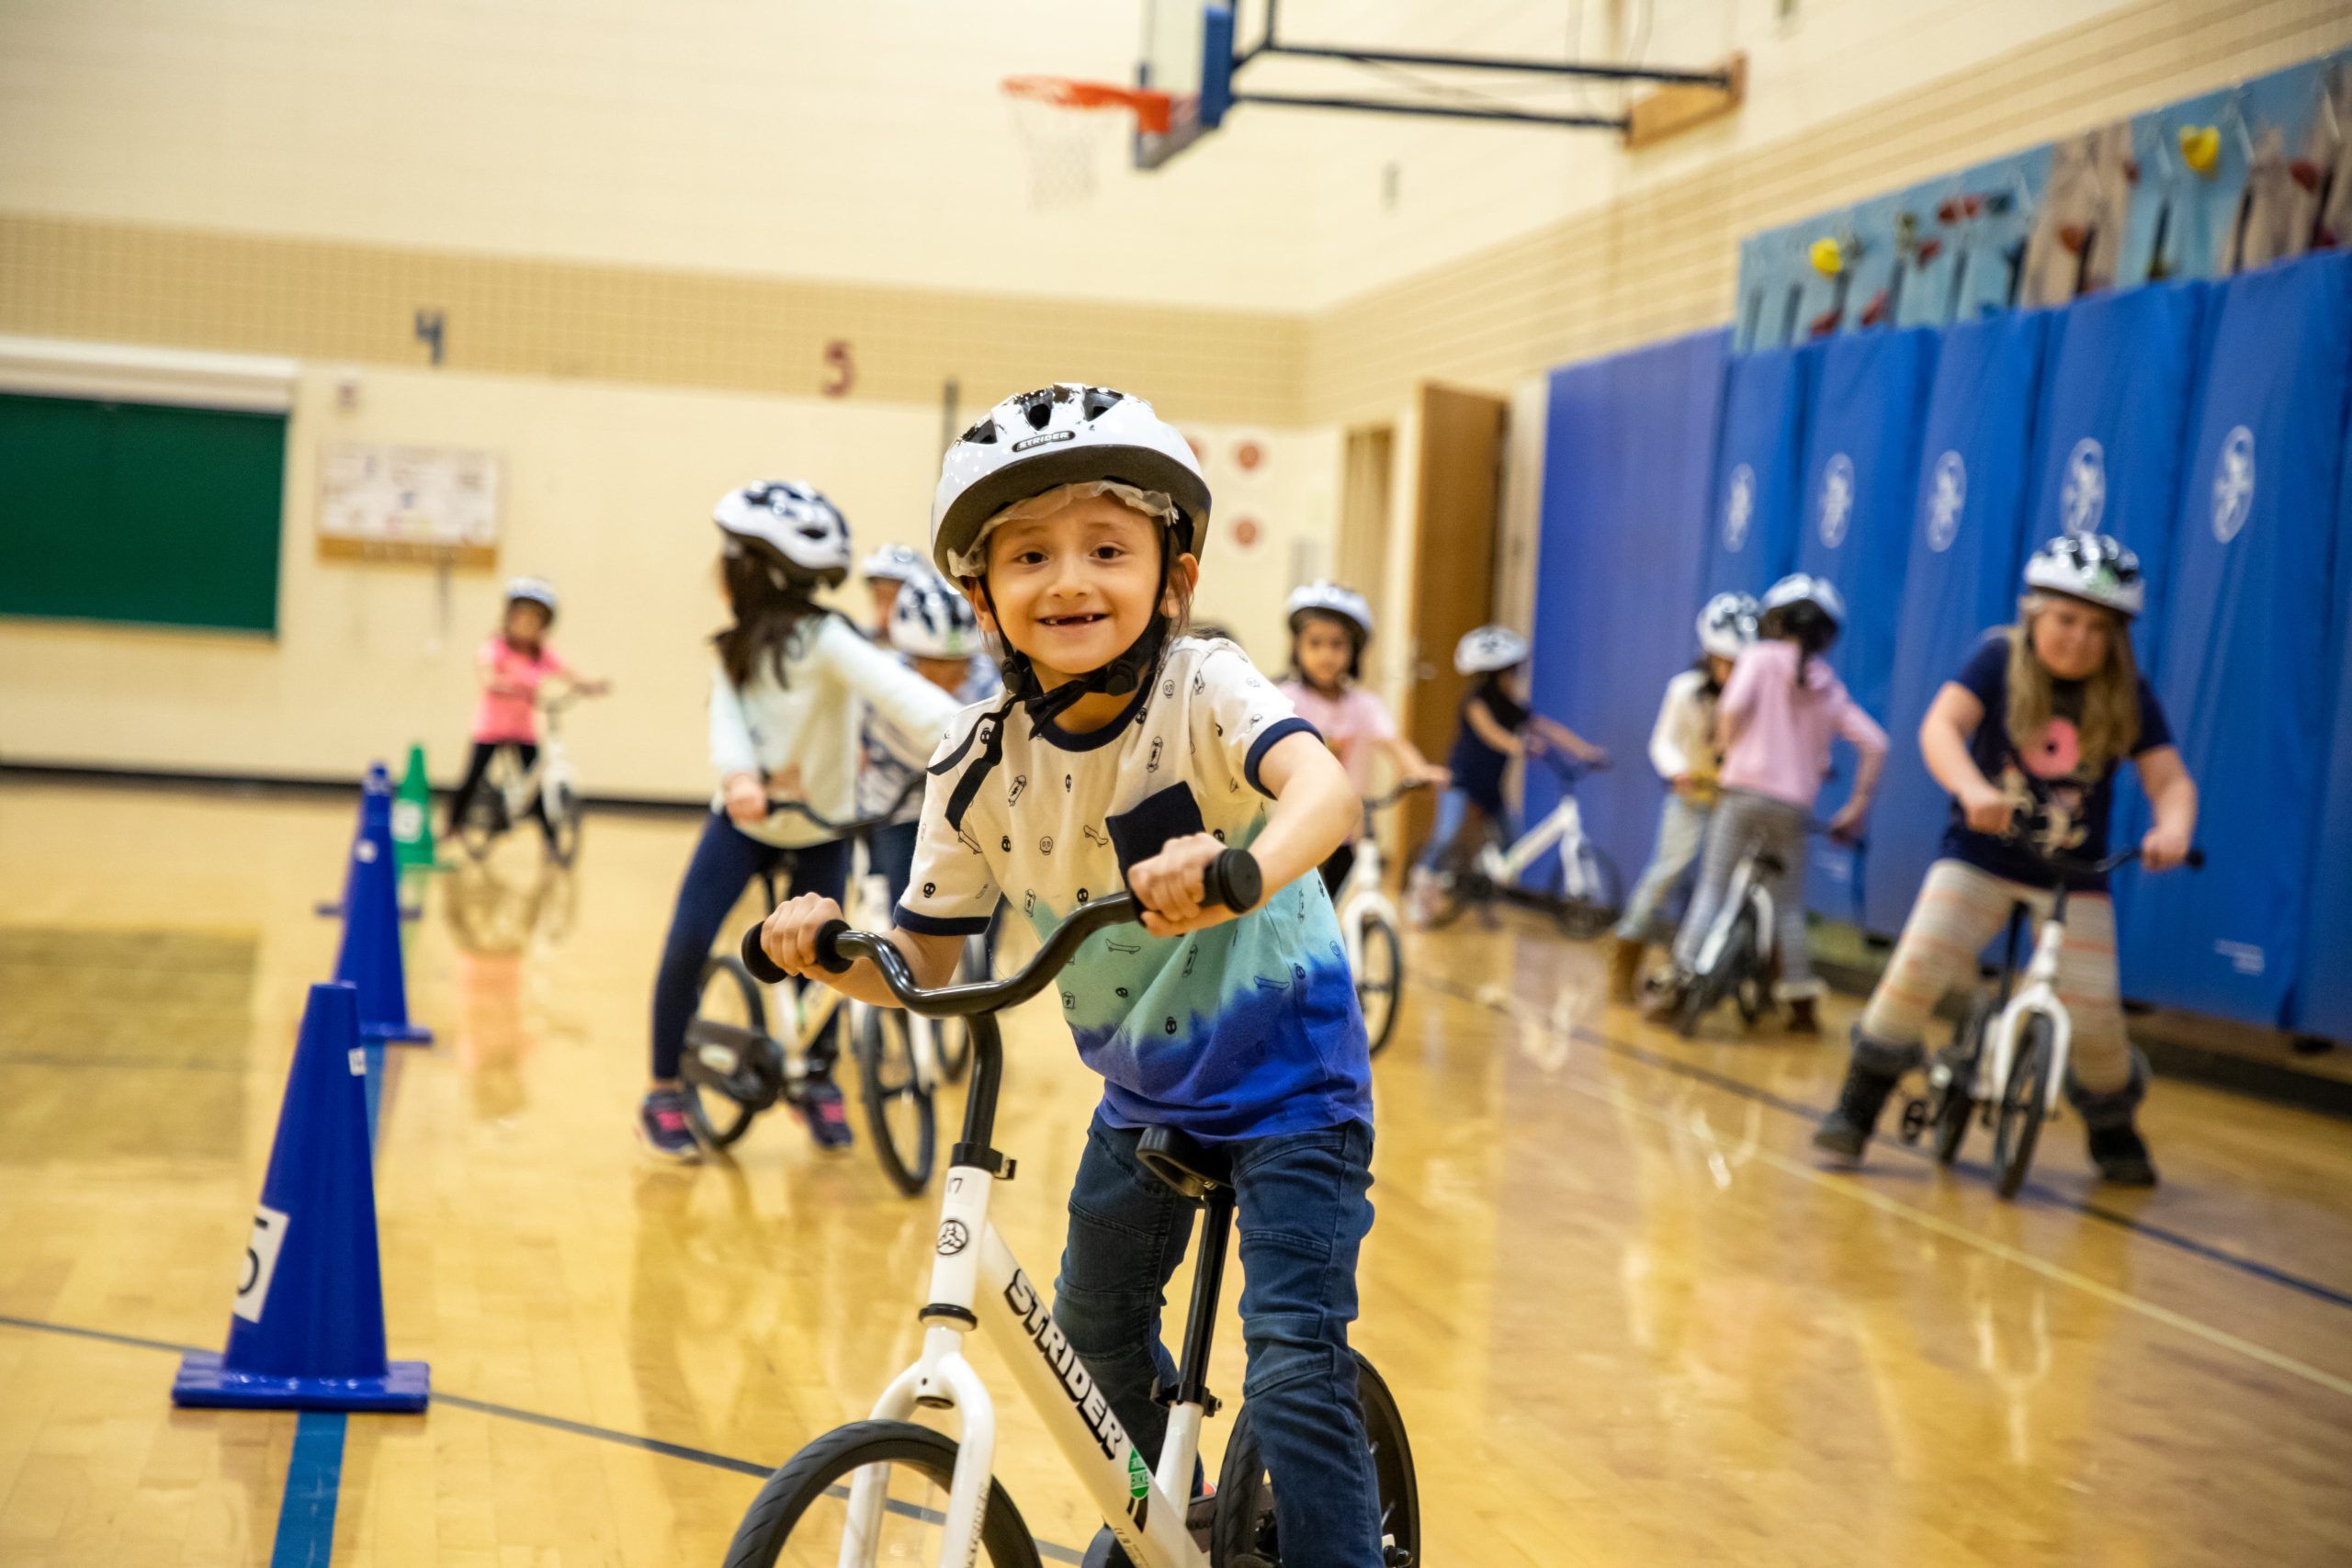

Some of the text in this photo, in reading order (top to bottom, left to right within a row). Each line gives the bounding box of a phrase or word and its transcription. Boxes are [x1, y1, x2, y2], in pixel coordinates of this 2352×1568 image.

[414, 310, 446, 368] 4
[823, 341, 854, 399] 5
[1015, 431, 1070, 451] STRIDER
[1003, 1269, 1123, 1461] STRIDER
